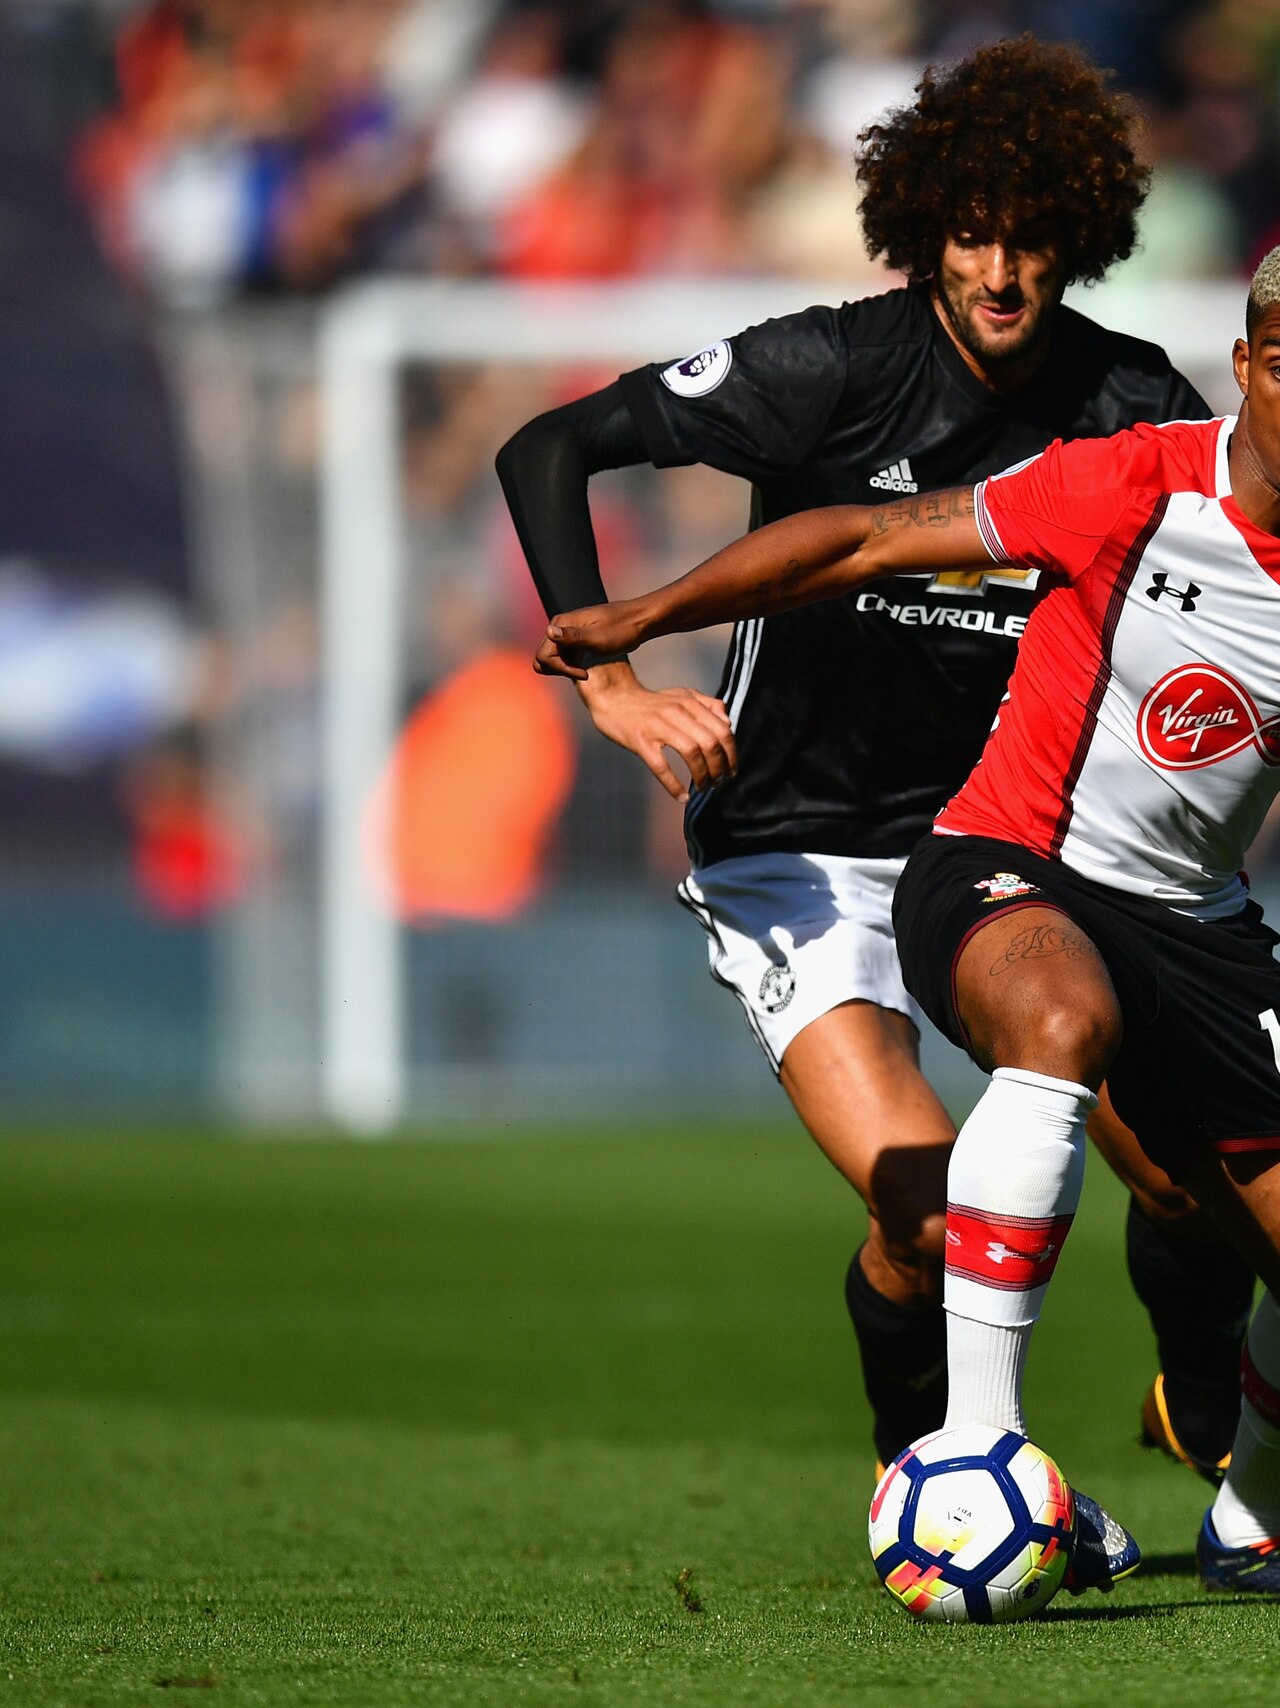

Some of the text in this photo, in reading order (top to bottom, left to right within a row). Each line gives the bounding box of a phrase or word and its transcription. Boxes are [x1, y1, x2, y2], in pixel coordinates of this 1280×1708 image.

[869, 477, 919, 494] adidas
[856, 593, 1029, 638] CHEVROLE
[1158, 688, 1240, 753] Virgin
